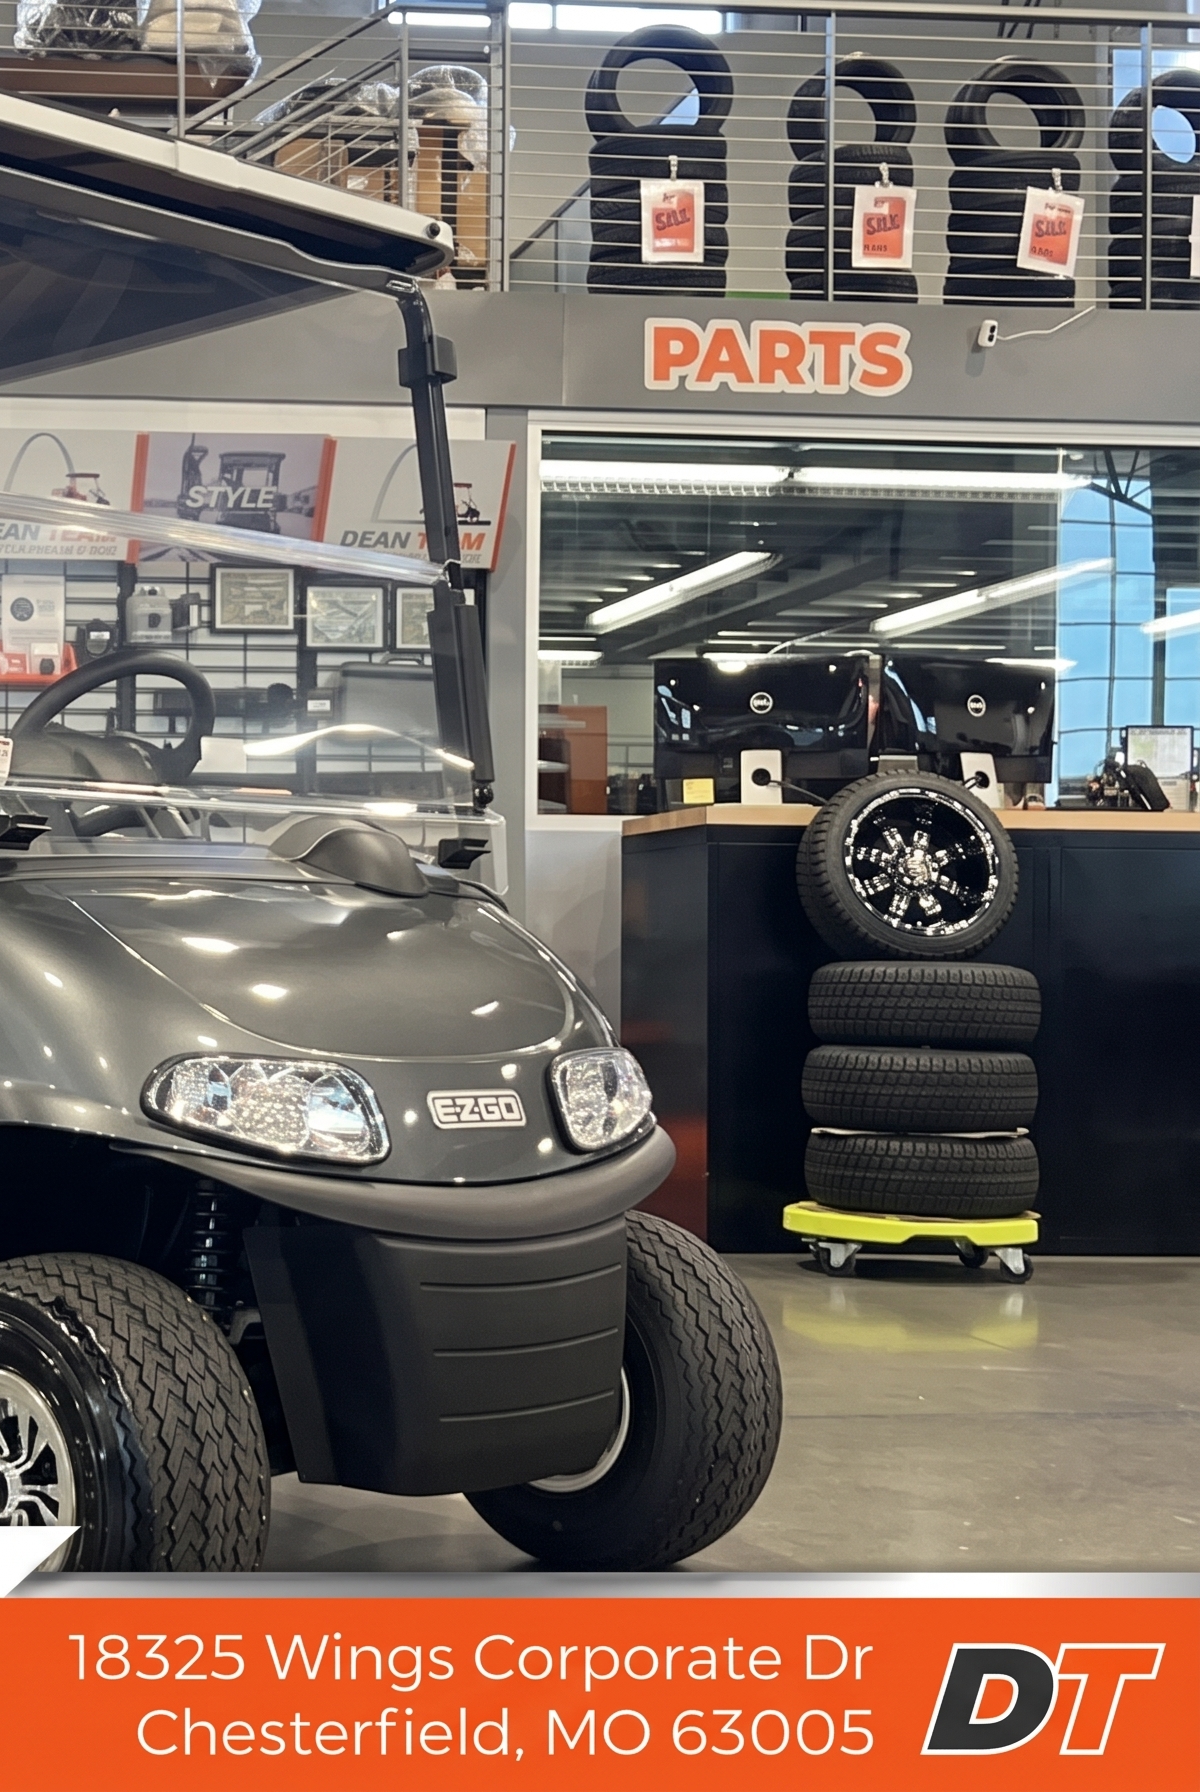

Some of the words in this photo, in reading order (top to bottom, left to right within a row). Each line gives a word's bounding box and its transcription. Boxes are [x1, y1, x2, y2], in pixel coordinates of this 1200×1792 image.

[650, 323, 907, 391] PARTS
[185, 485, 278, 508] STYLE
[340, 530, 411, 549] DEAN
[417, 531, 486, 551] TM
